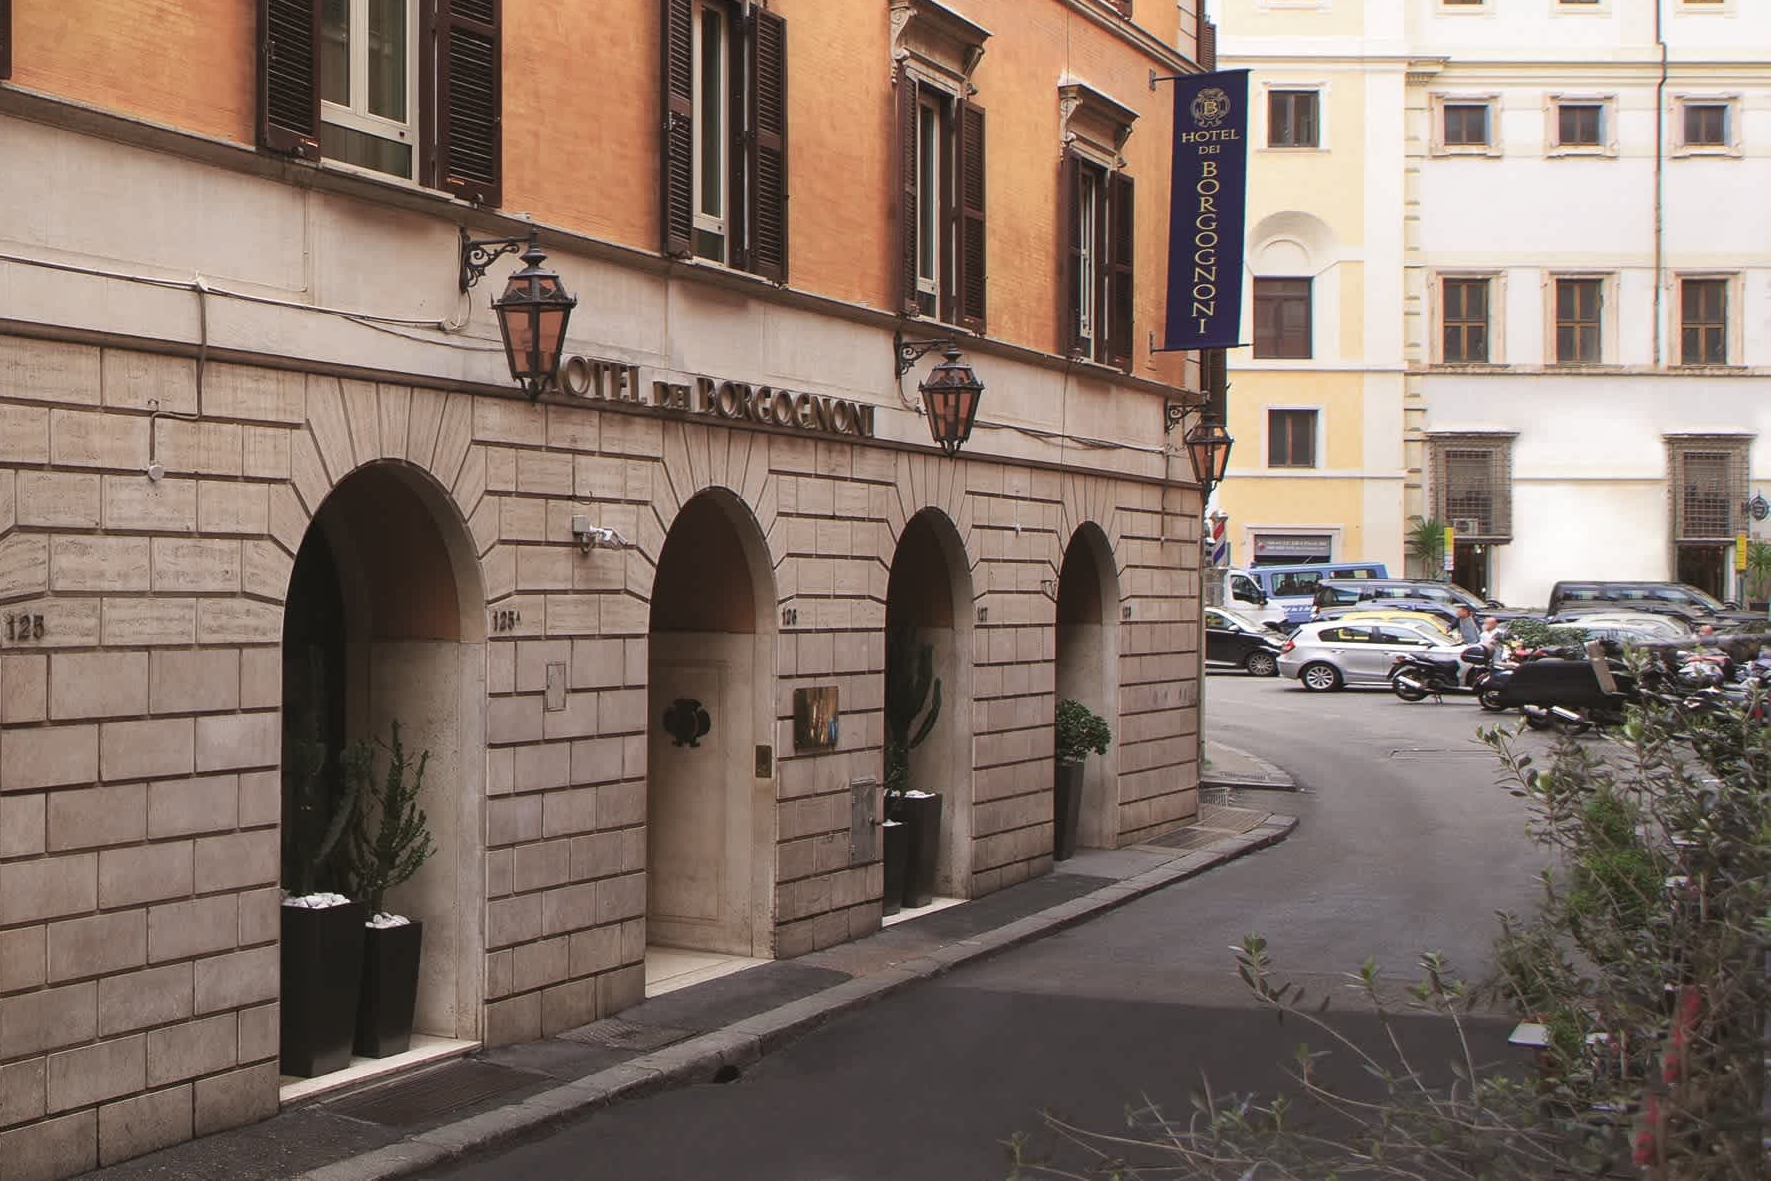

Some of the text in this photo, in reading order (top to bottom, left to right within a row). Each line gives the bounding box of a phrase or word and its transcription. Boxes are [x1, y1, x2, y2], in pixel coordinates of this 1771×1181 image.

[1181, 128, 1240, 144] HOTEL
[1198, 144, 1221, 155] DEI
[1190, 161, 1221, 335] BORGOGNONI
[652, 380, 692, 410] DEI
[696, 376, 875, 437] BORGOGNONI
[5, 613, 45, 641] 125
[782, 608, 797, 626] 126
